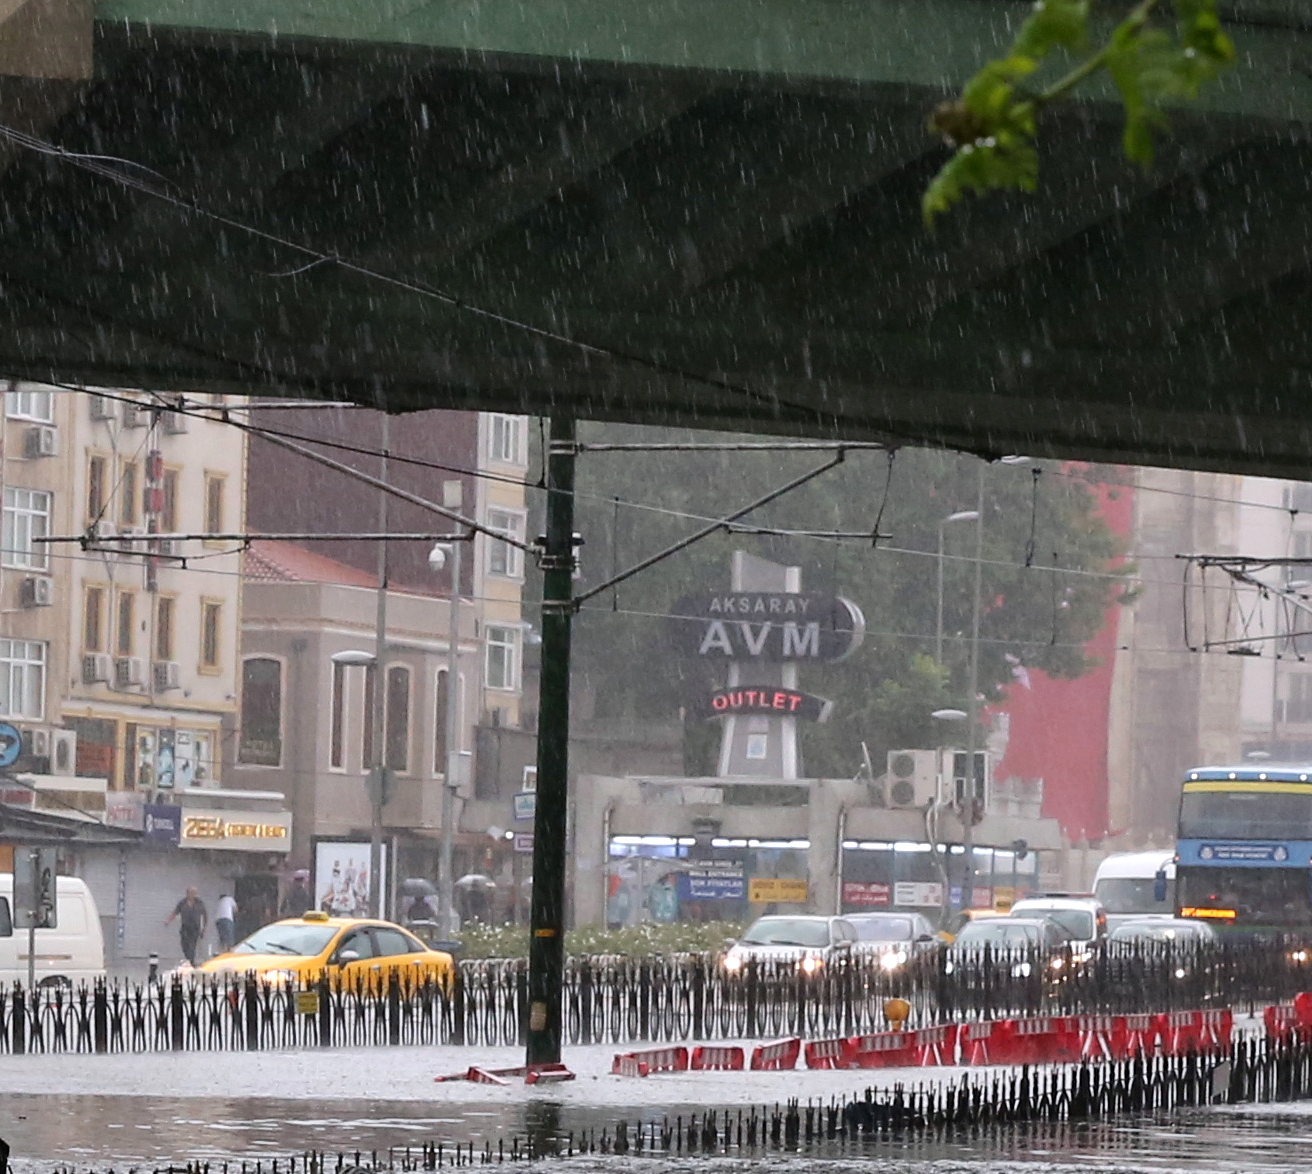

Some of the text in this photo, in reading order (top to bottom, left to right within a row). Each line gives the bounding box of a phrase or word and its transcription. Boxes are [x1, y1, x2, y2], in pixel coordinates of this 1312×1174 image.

[709, 597, 810, 613] AKSARAY
[698, 619, 819, 657] AVM
[711, 690, 802, 712] OUTLET
